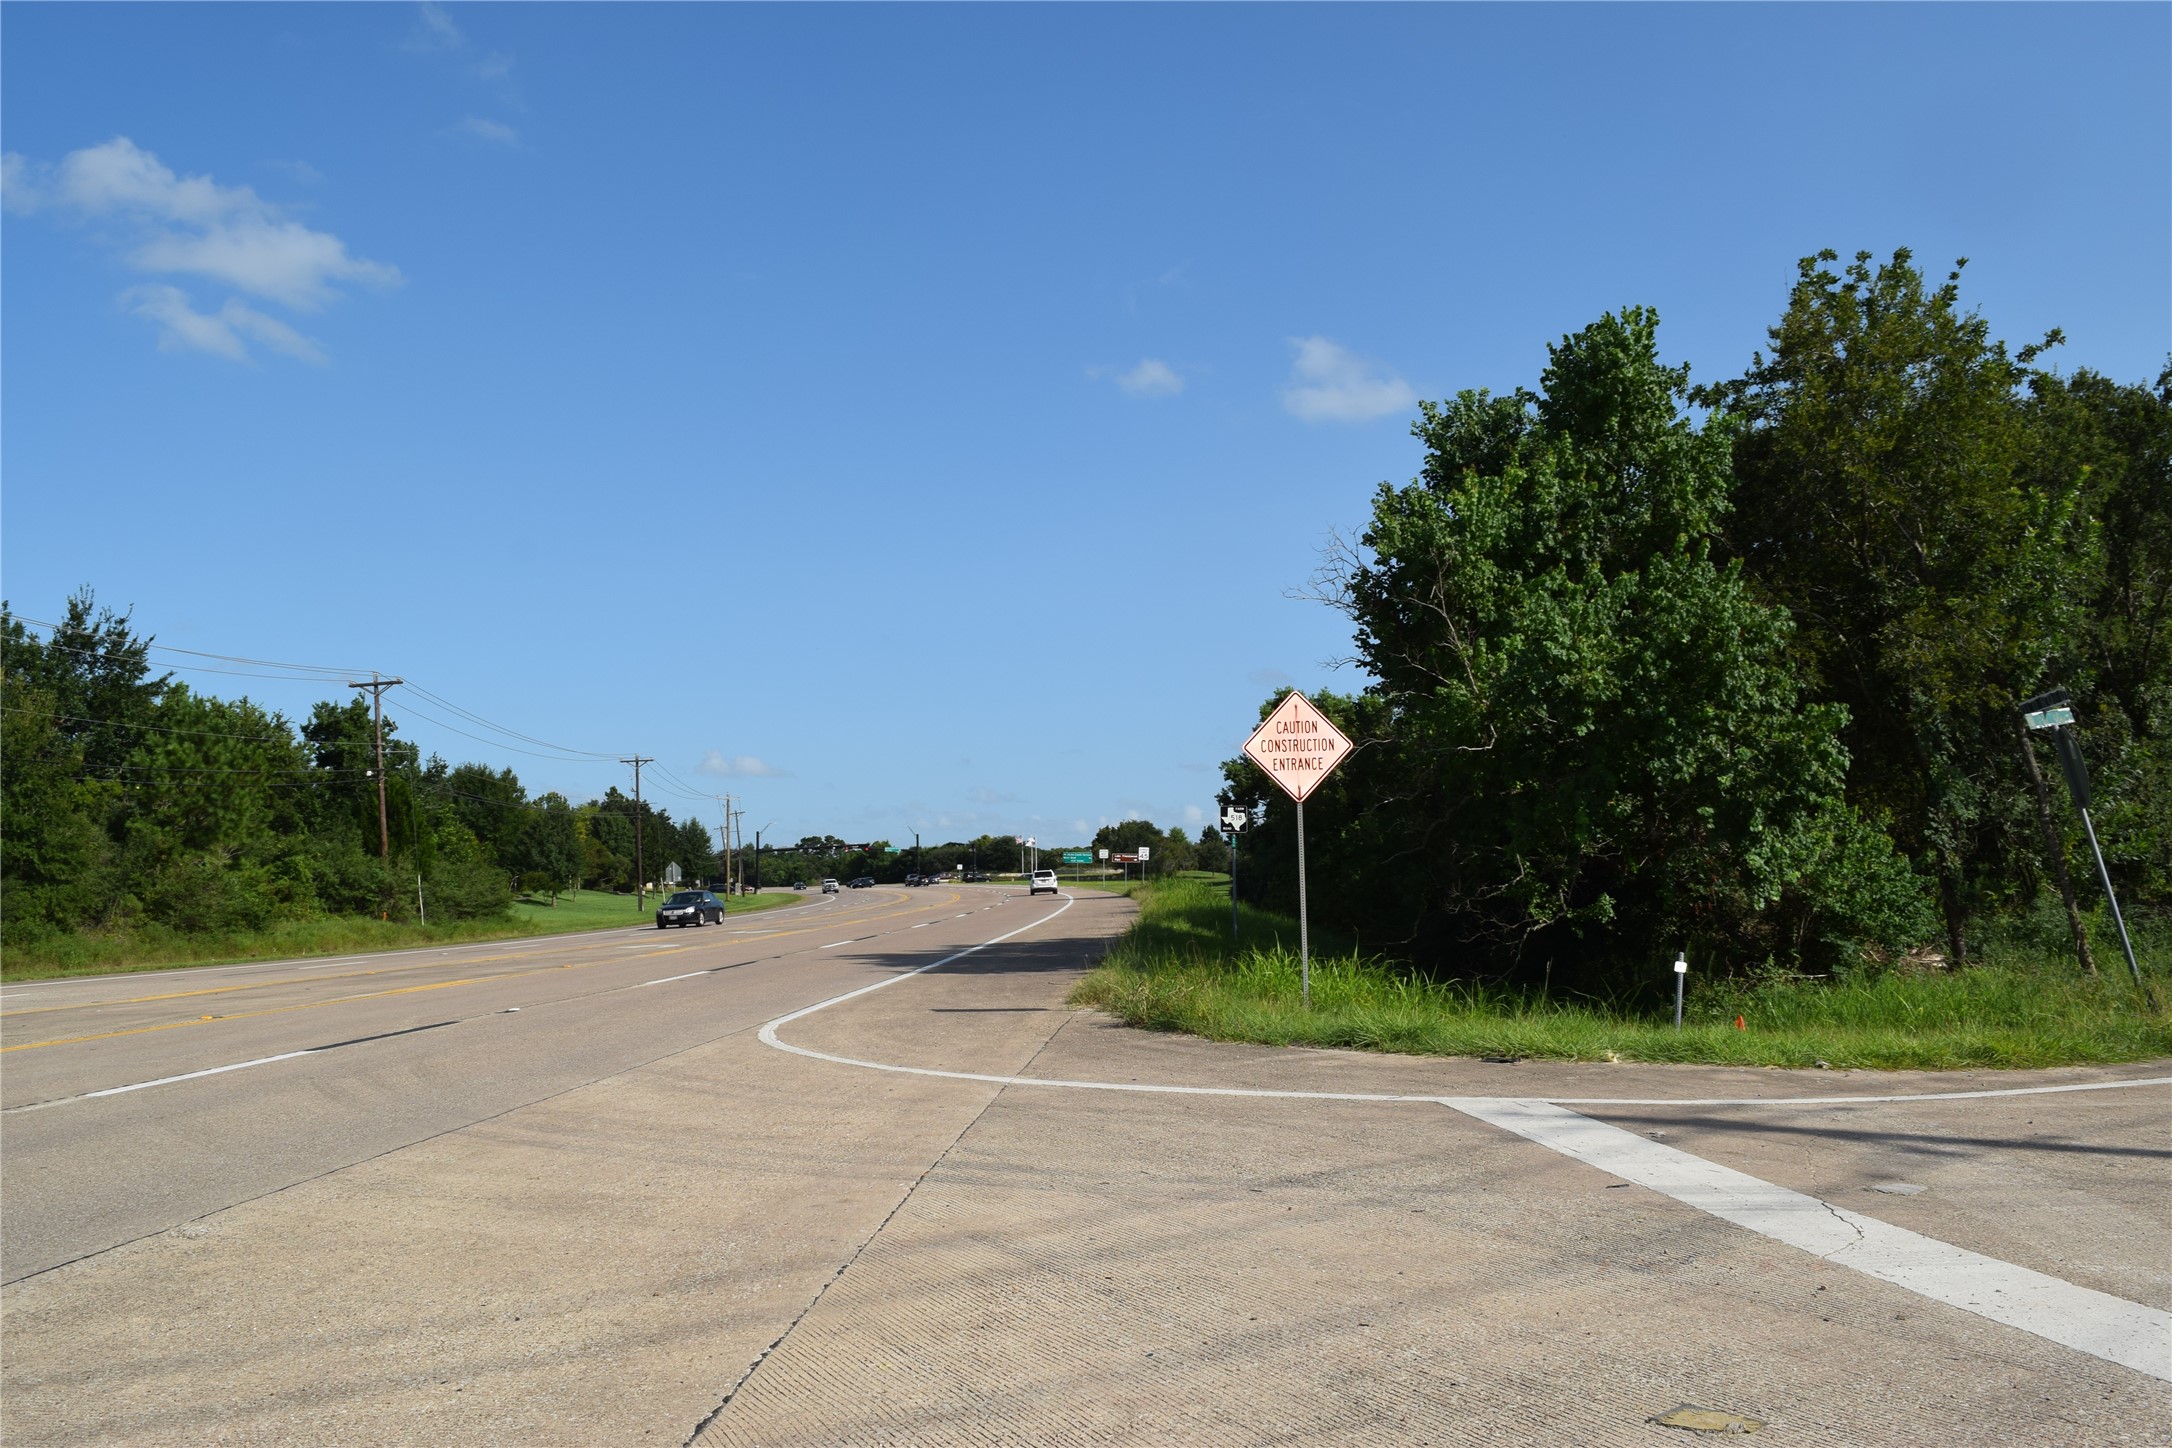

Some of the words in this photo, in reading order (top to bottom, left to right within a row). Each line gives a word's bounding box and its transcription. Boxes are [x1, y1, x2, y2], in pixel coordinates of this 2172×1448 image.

[1276, 721, 1318, 734] CAUTION
[1261, 738, 1335, 752] CONSTRUCTION
[1273, 757, 1324, 771] ENTRANCE
